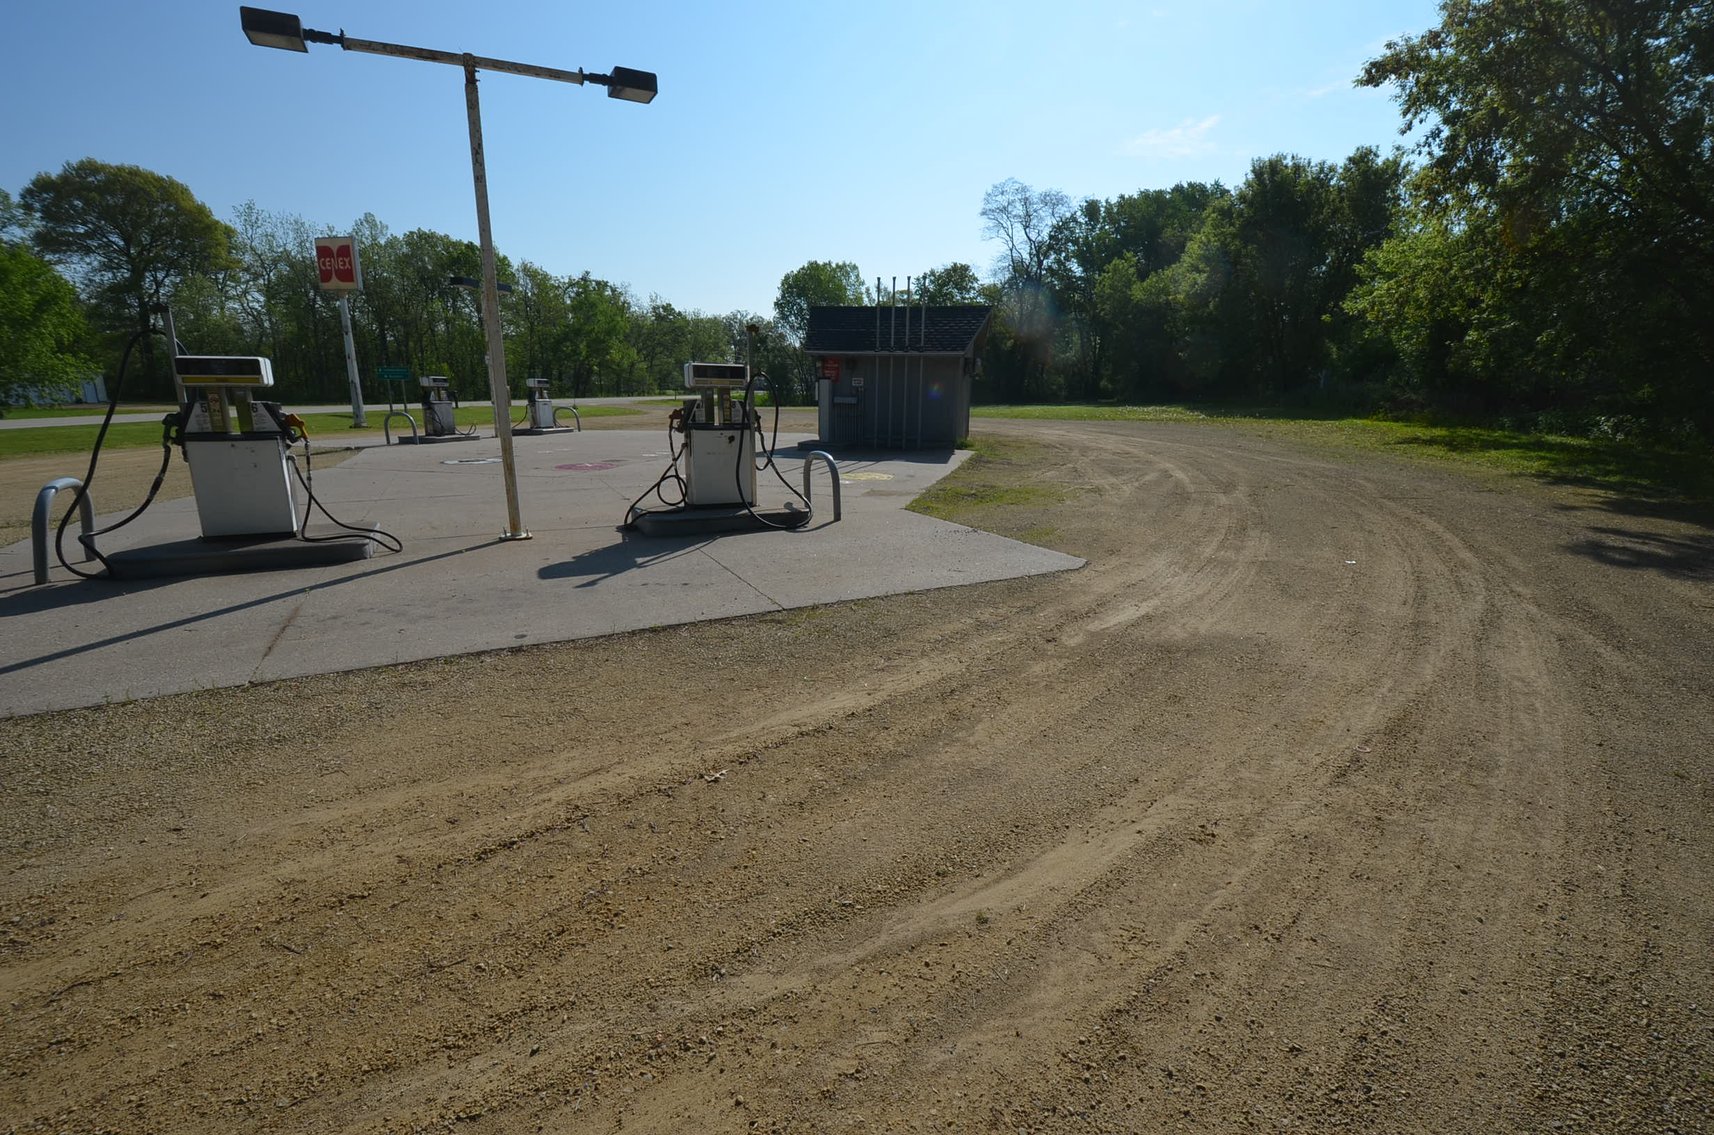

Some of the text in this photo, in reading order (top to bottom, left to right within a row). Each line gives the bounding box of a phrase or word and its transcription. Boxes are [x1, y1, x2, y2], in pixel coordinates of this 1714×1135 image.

[320, 257, 351, 270] CENEX
[201, 403, 208, 413] 5
[251, 403, 258, 412] 6
